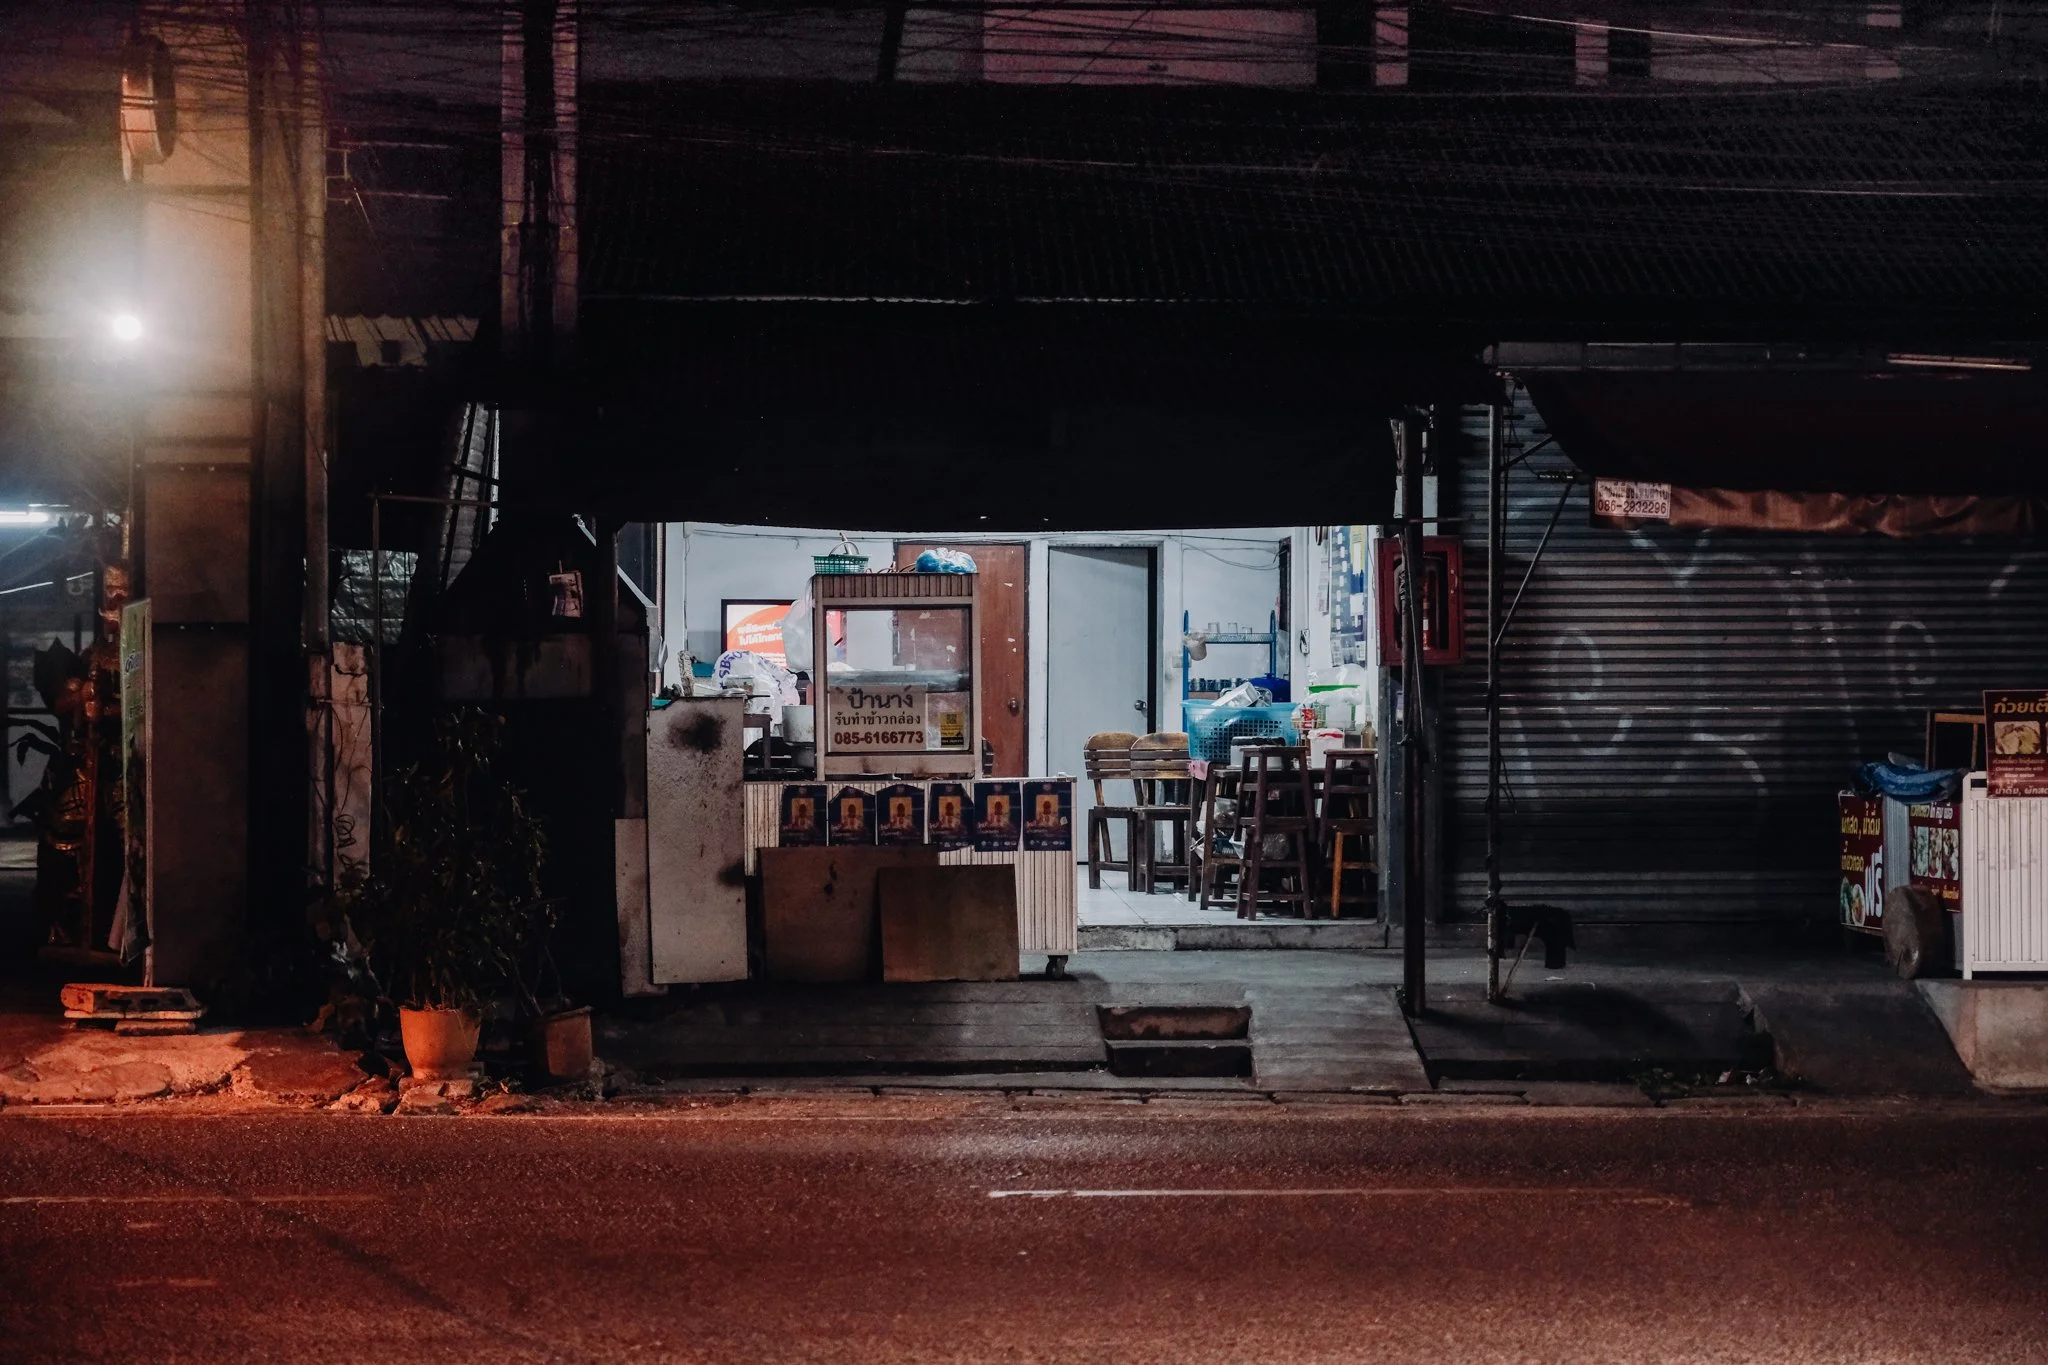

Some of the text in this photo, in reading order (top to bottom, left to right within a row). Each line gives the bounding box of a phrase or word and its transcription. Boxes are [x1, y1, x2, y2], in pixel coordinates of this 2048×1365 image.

[834, 711, 921, 726] รับทำข้าวกล่อง
[834, 731, 924, 745] 085-6166773
